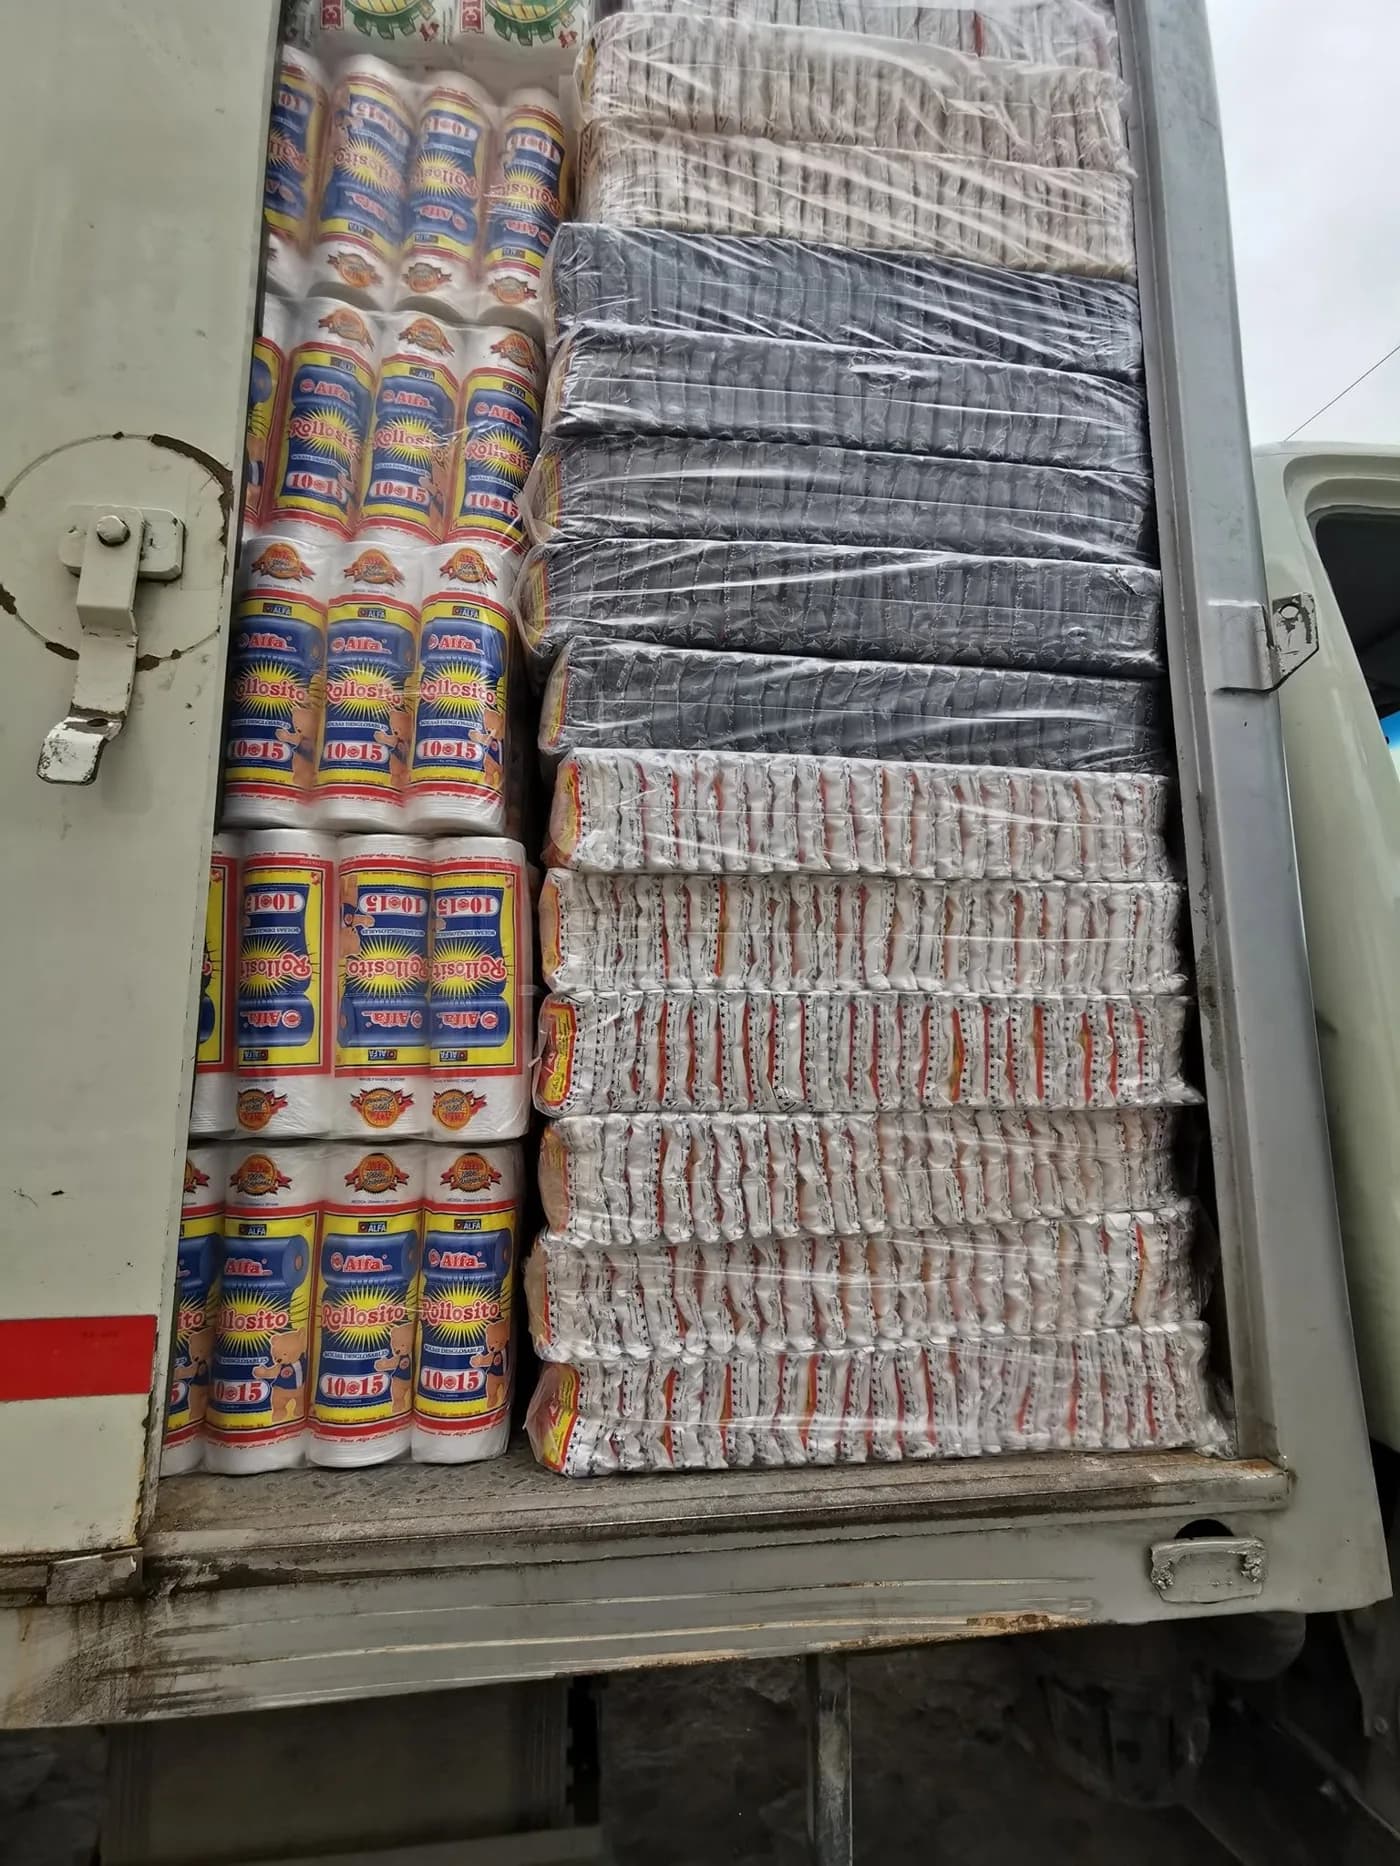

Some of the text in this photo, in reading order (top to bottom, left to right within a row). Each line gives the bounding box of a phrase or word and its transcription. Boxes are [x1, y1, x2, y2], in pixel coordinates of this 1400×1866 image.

[466, 439, 531, 472] Rollosit
[375, 482, 426, 503] 10 15
[470, 494, 490, 508] 10
[249, 633, 287, 649] Alfa
[345, 637, 382, 653] Alfa
[438, 635, 476, 652] Alfa
[233, 678, 306, 703] ollosito
[326, 679, 402, 705] Rollosito
[421, 678, 496, 705] Rollosito
[262, 741, 284, 759] 15
[327, 743, 382, 761] 10 15
[422, 741, 476, 760] 10 15
[273, 893, 297, 912] 10
[366, 894, 424, 914] 10 15
[438, 896, 492, 915] 10 15
[240, 951, 313, 981] Rollosi
[347, 954, 429, 982] Rollosito
[432, 954, 508, 982] Rollosit
[248, 1011, 283, 1029] Alfa
[370, 1011, 411, 1029] Alfa
[442, 1012, 481, 1030] Alfa
[248, 1226, 266, 1236] ALFA
[367, 1224, 386, 1233] ALFA
[463, 1222, 481, 1231] ALFA
[225, 1258, 262, 1276] Alfa
[343, 1255, 383, 1273] Alfa
[440, 1252, 477, 1269] Alfa
[216, 1308, 289, 1333] llosito
[322, 1302, 406, 1333] Rollosito
[419, 1297, 500, 1327] Rollosito
[327, 1374, 384, 1397] 10 15
[424, 1369, 479, 1391] 10 15
[239, 1382, 262, 1402] 15
